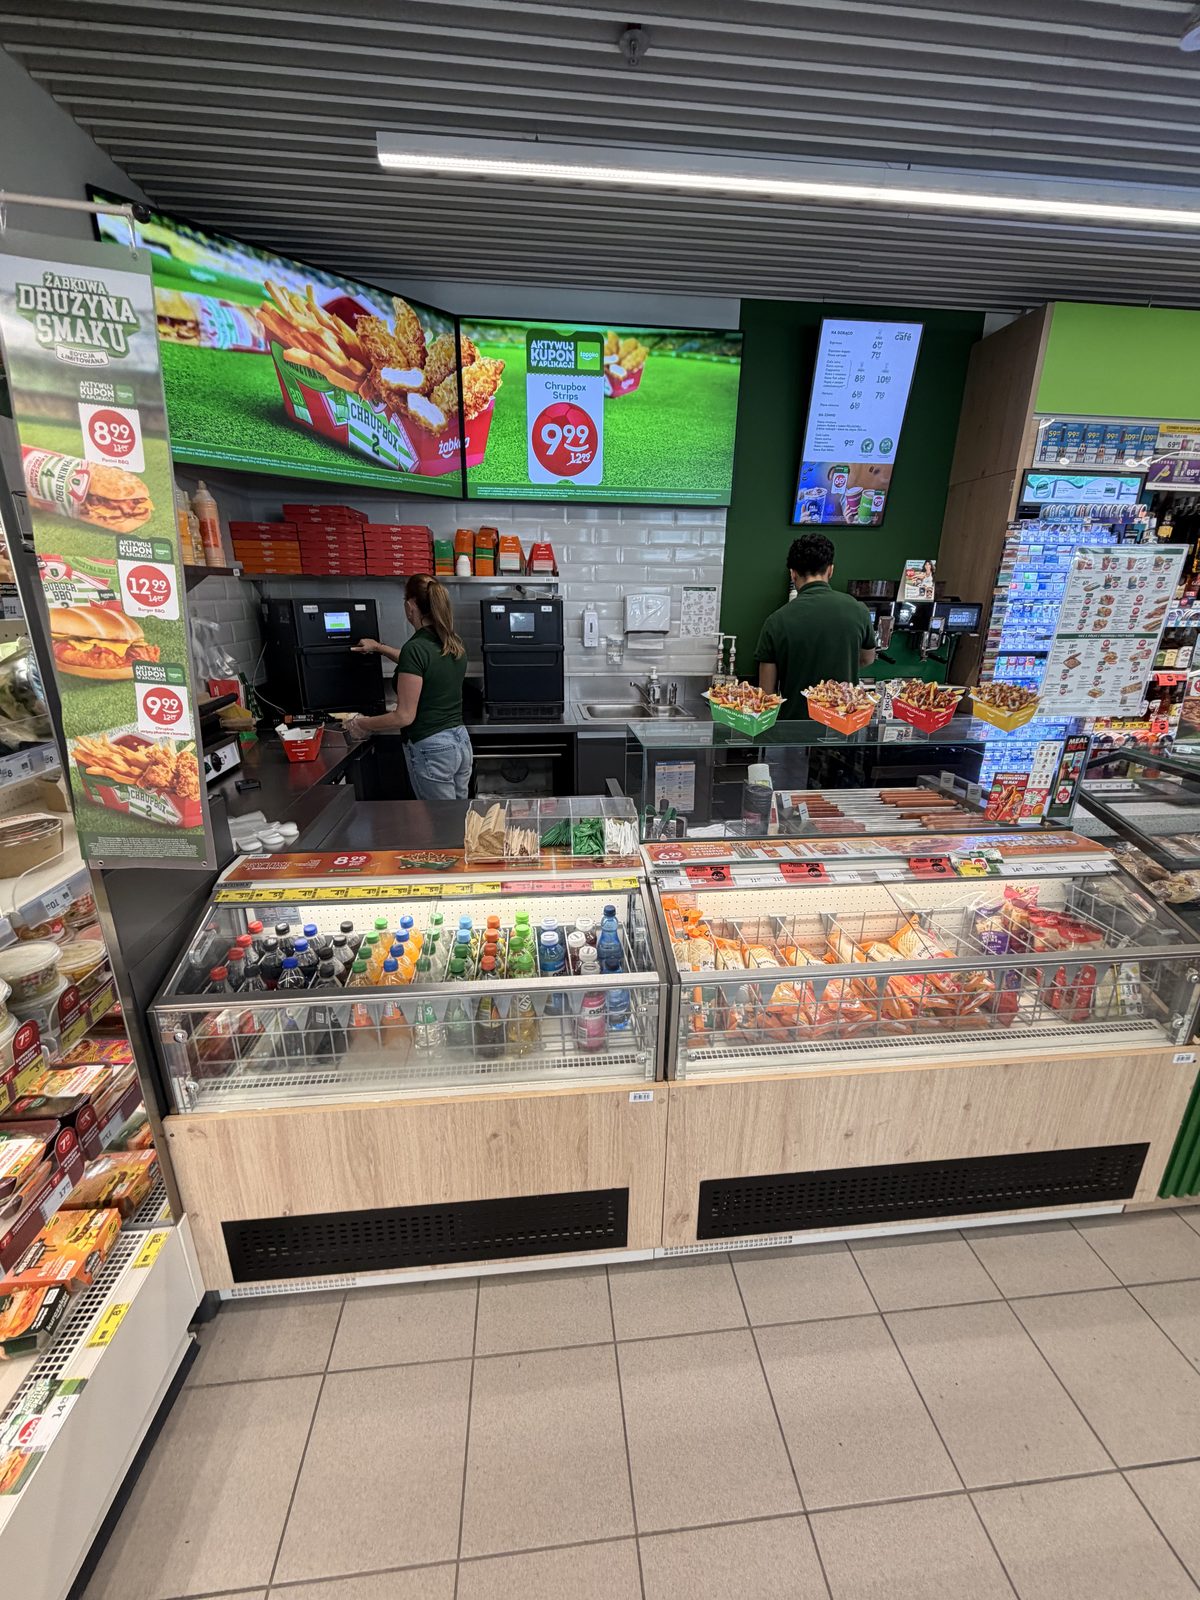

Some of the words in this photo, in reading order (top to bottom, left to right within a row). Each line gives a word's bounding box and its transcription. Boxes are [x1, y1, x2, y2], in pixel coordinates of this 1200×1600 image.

[44, 272, 107, 294] ŻABKOWA
[17, 285, 137, 324] DRUŻYNA
[36, 315, 127, 352] SMAKU
[894, 332, 912, 341] café
[530, 340, 574, 350] AKTYWUJ
[60, 353, 105, 365] LIMITOWANA
[69, 351, 96, 359] EDYCJA
[530, 349, 575, 361] KUPON
[538, 361, 575, 369] APLIKACJI
[79, 381, 114, 389] AKTYWUJ
[544, 381, 587, 393] Chrupbox
[79, 386, 114, 397] KUPON
[552, 391, 578, 401] Strips
[351, 403, 399, 451] CHRUPBOX
[372, 434, 380, 455] 2
[119, 539, 151, 548] AKTYWUJ
[119, 546, 153, 554] KUPON
[44, 583, 77, 592] BURGER
[137, 606, 154, 614] Burger
[135, 665, 165, 673] AKTYWUJ
[1068, 737, 1088, 745] MEAL
[130, 788, 167, 814] CHRUPBOX
[146, 805, 152, 818] 2
